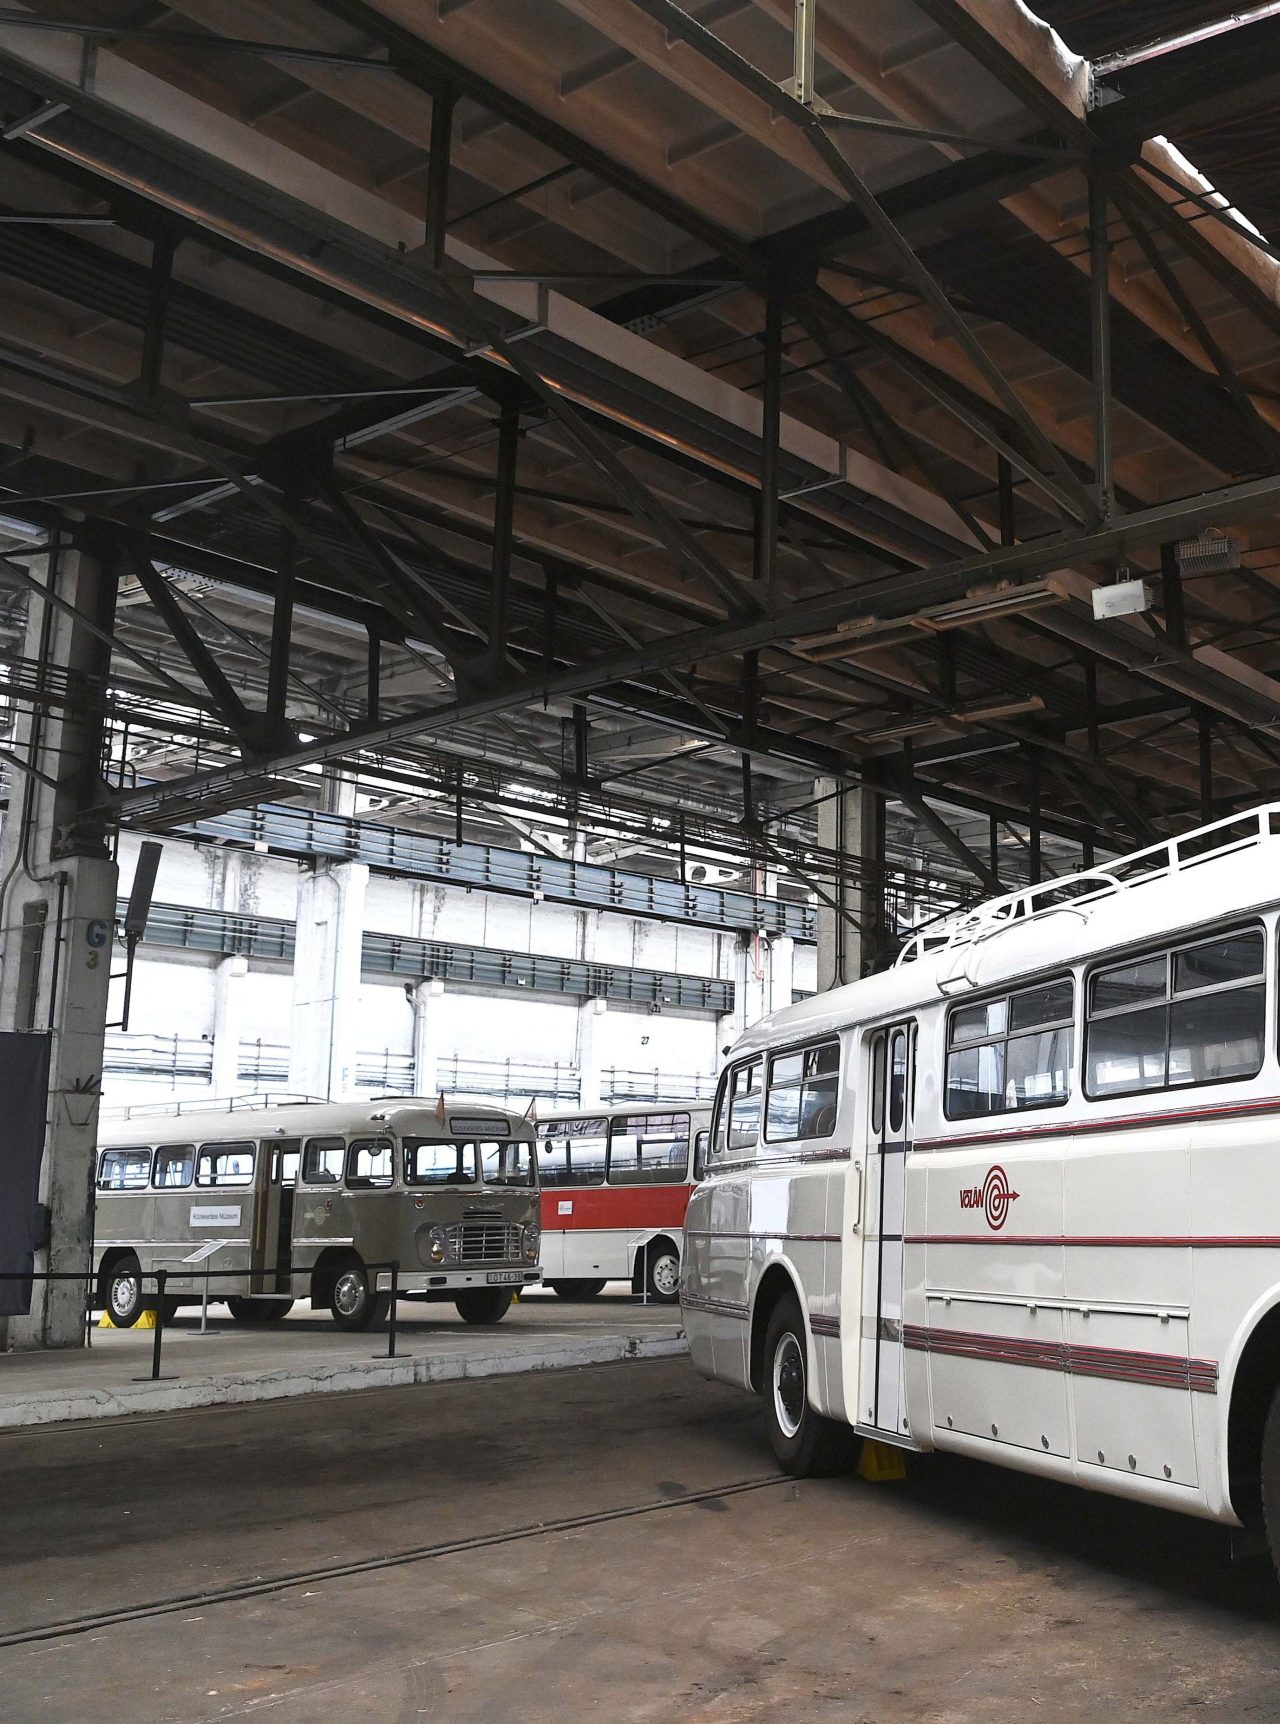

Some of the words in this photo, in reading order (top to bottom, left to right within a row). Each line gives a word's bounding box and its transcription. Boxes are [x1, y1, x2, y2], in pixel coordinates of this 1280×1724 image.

[86, 920, 107, 948] G
[86, 950, 99, 970] 3
[641, 1036, 650, 1045] 27
[960, 1186, 984, 1209] VOLÁN
